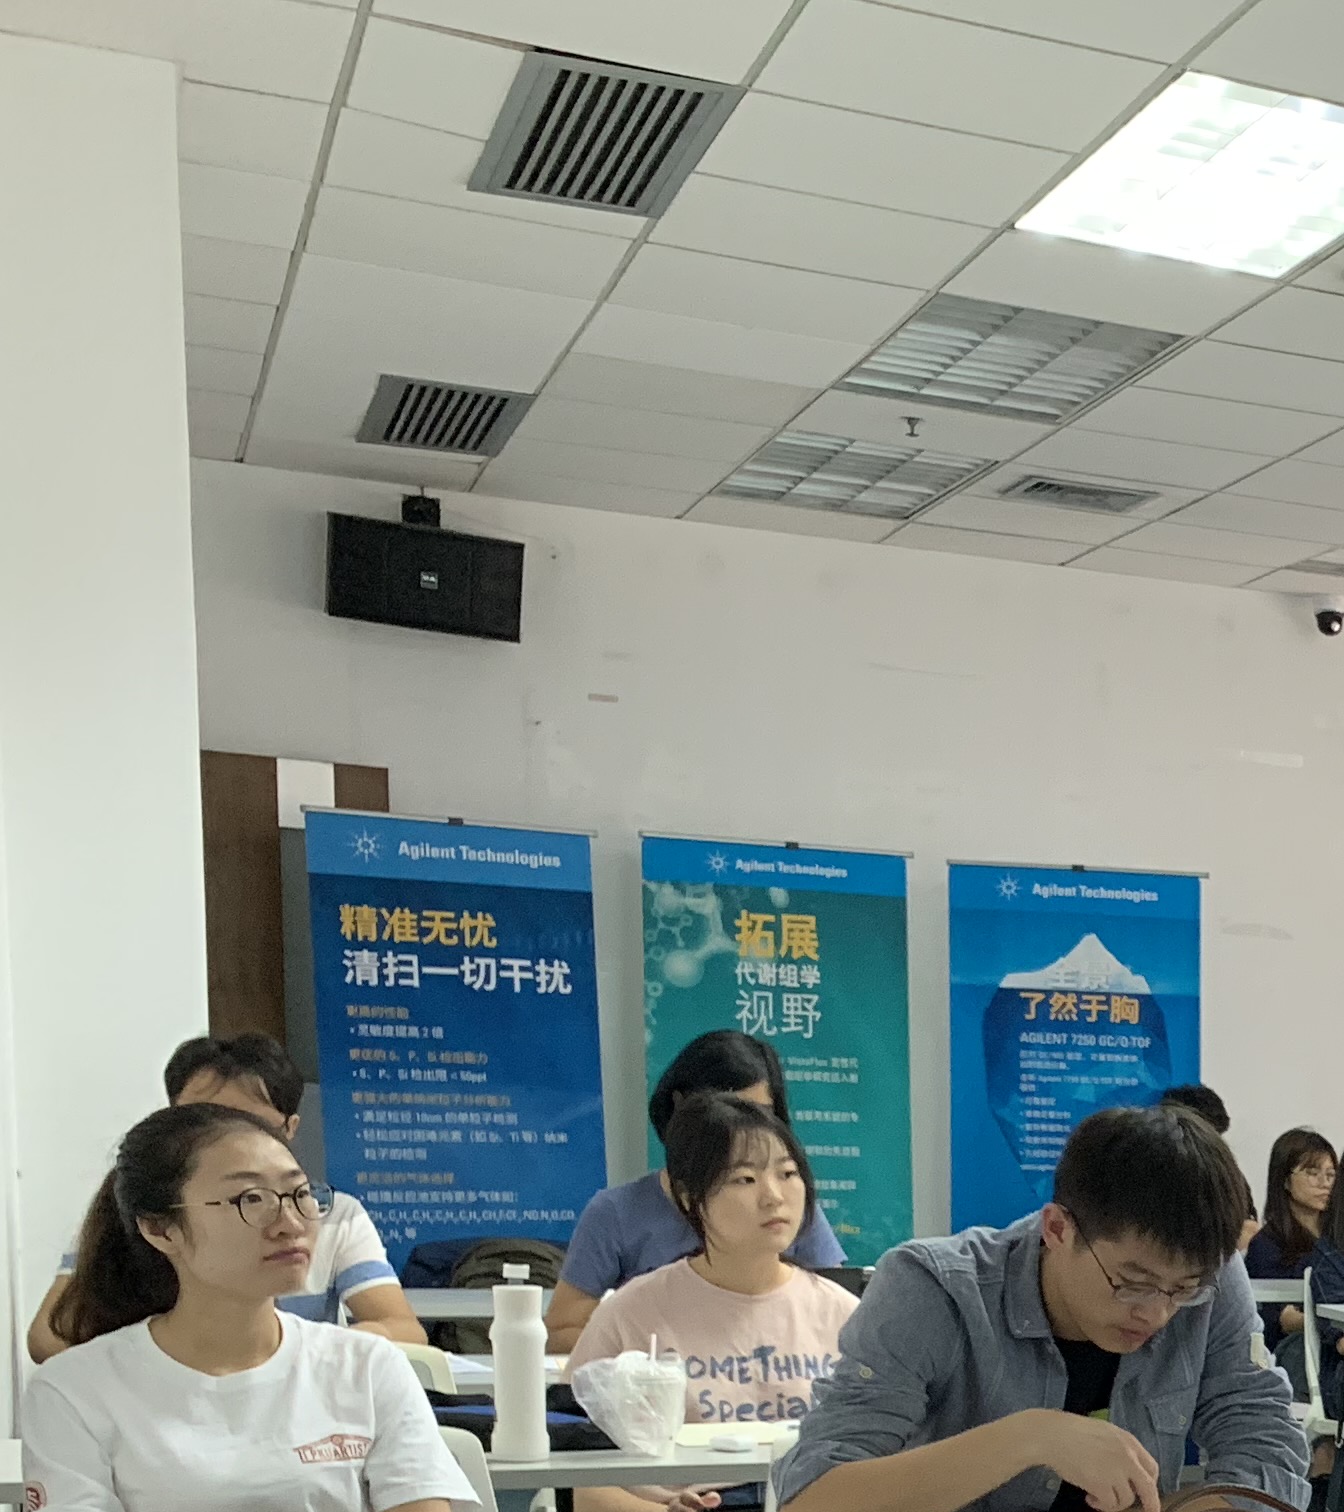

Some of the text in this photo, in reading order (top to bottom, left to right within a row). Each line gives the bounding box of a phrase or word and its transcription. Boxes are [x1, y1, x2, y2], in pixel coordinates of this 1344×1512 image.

[398, 840, 562, 869] Agilent Technologies
[735, 858, 848, 879] Agilent Technologies
[1033, 883, 1159, 903] Agilent Technologies
[339, 904, 498, 949] 精准无忧
[734, 909, 820, 961] 拓展
[342, 949, 573, 995] 清扫一切干扰
[735, 963, 821, 989] 代谢组学
[735, 990, 822, 1039] 视野
[1019, 991, 1141, 1025] 了然于胸
[676, 1345, 837, 1385] OMETHING
[699, 1389, 809, 1423] Specia
